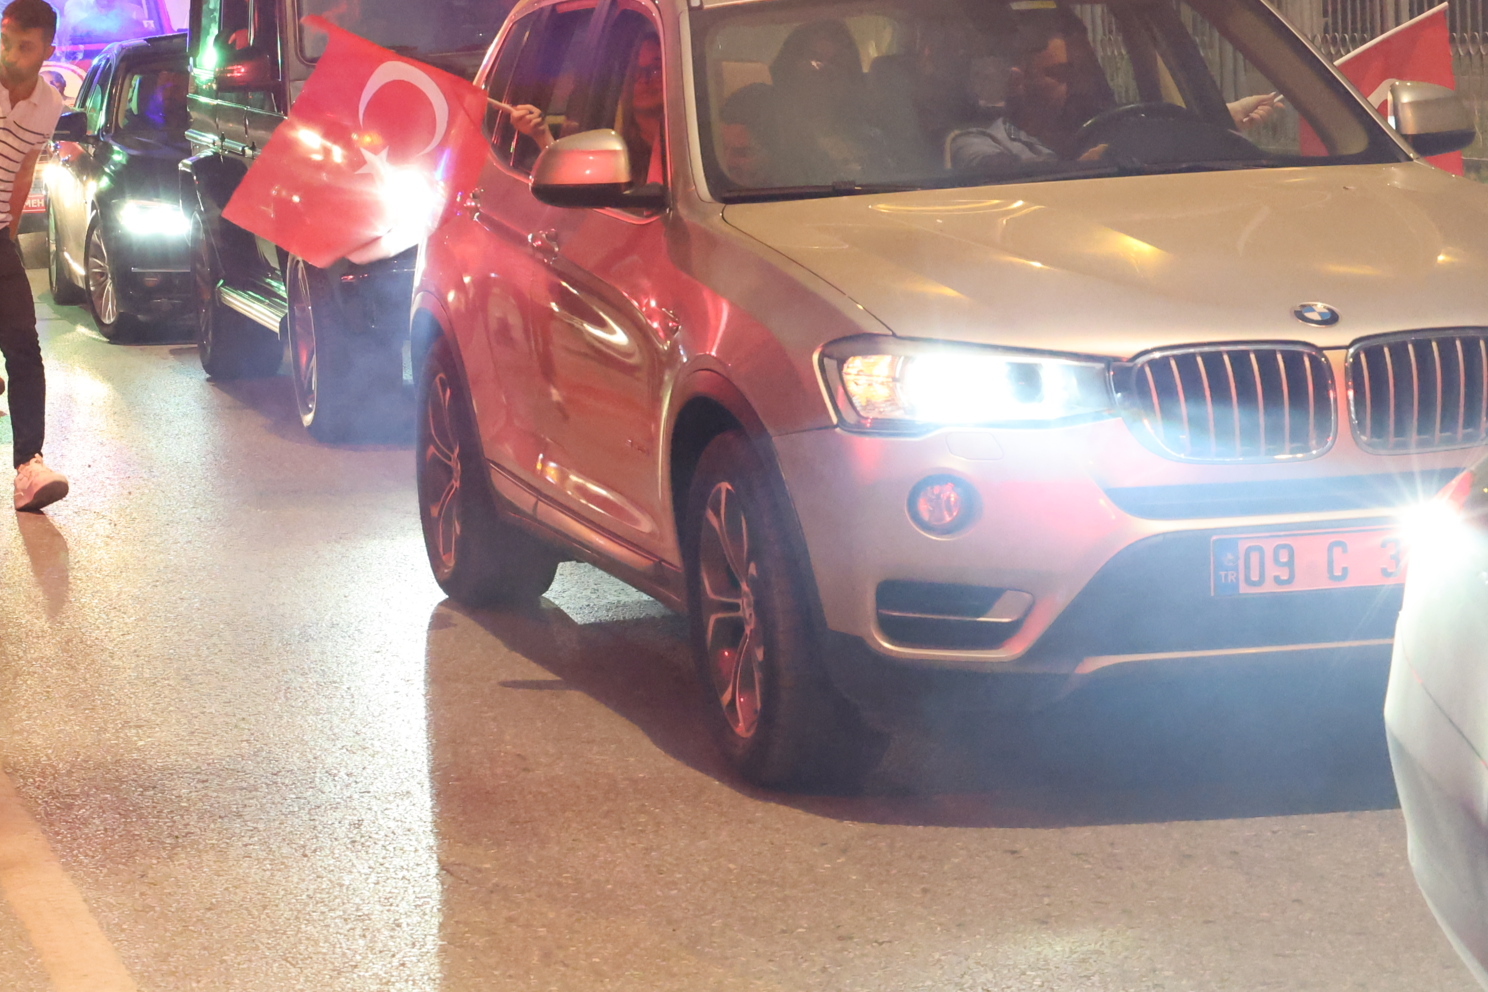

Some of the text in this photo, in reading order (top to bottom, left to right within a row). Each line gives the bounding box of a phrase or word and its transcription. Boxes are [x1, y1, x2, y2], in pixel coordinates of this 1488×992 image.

[1220, 571, 1237, 584] TR
[1243, 543, 1296, 587] 09
[1327, 540, 1349, 582] C
